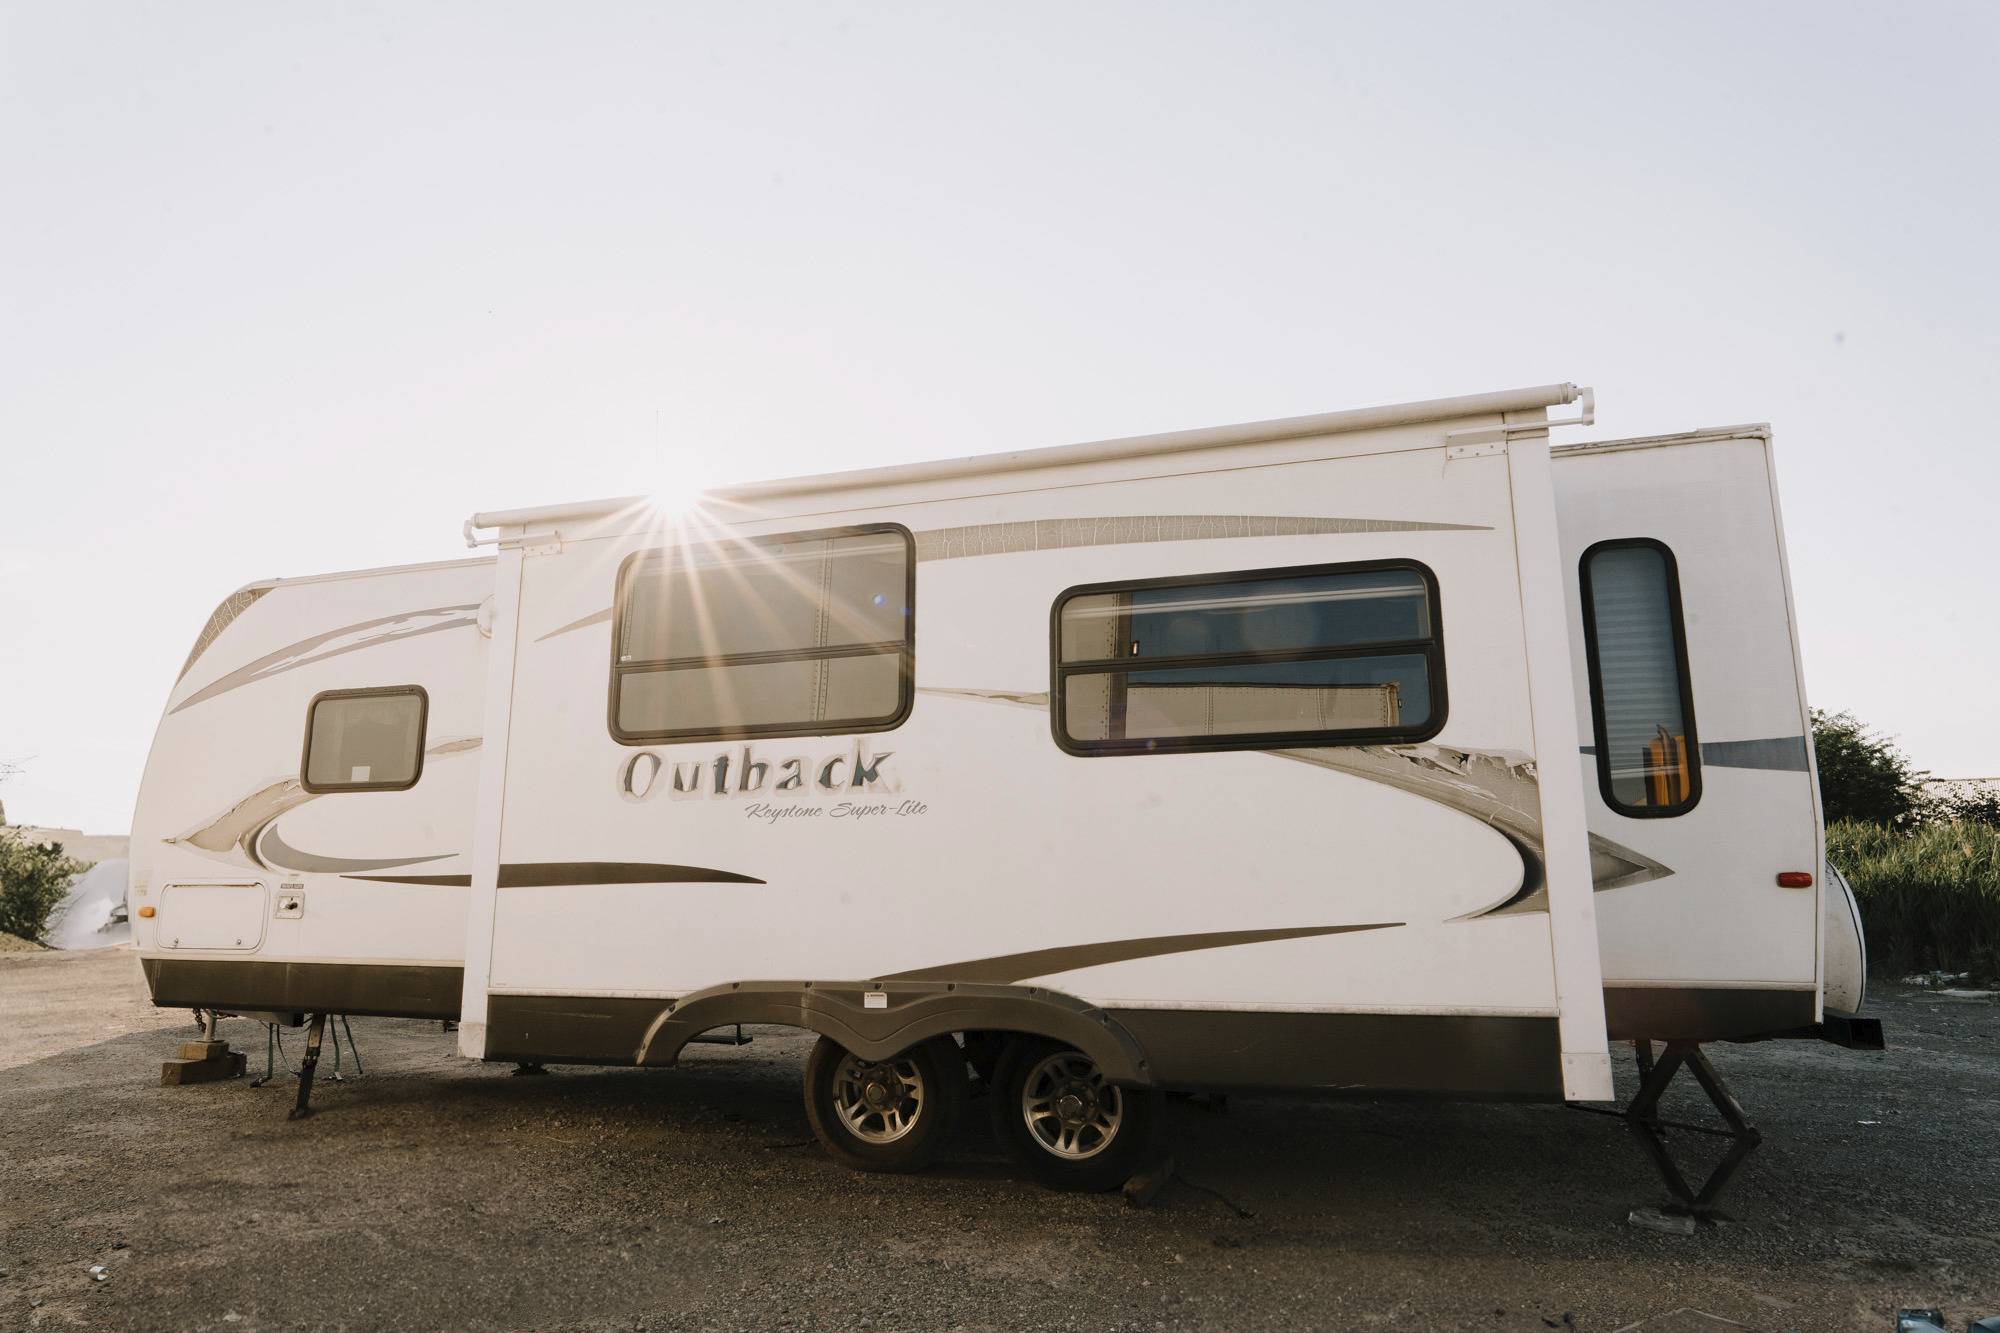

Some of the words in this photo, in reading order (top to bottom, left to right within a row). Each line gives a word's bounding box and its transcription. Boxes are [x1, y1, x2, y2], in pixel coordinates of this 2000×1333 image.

[621, 739, 897, 799] Outback
[744, 803, 823, 825] Keystone
[829, 800, 929, 820] Super-Lite
